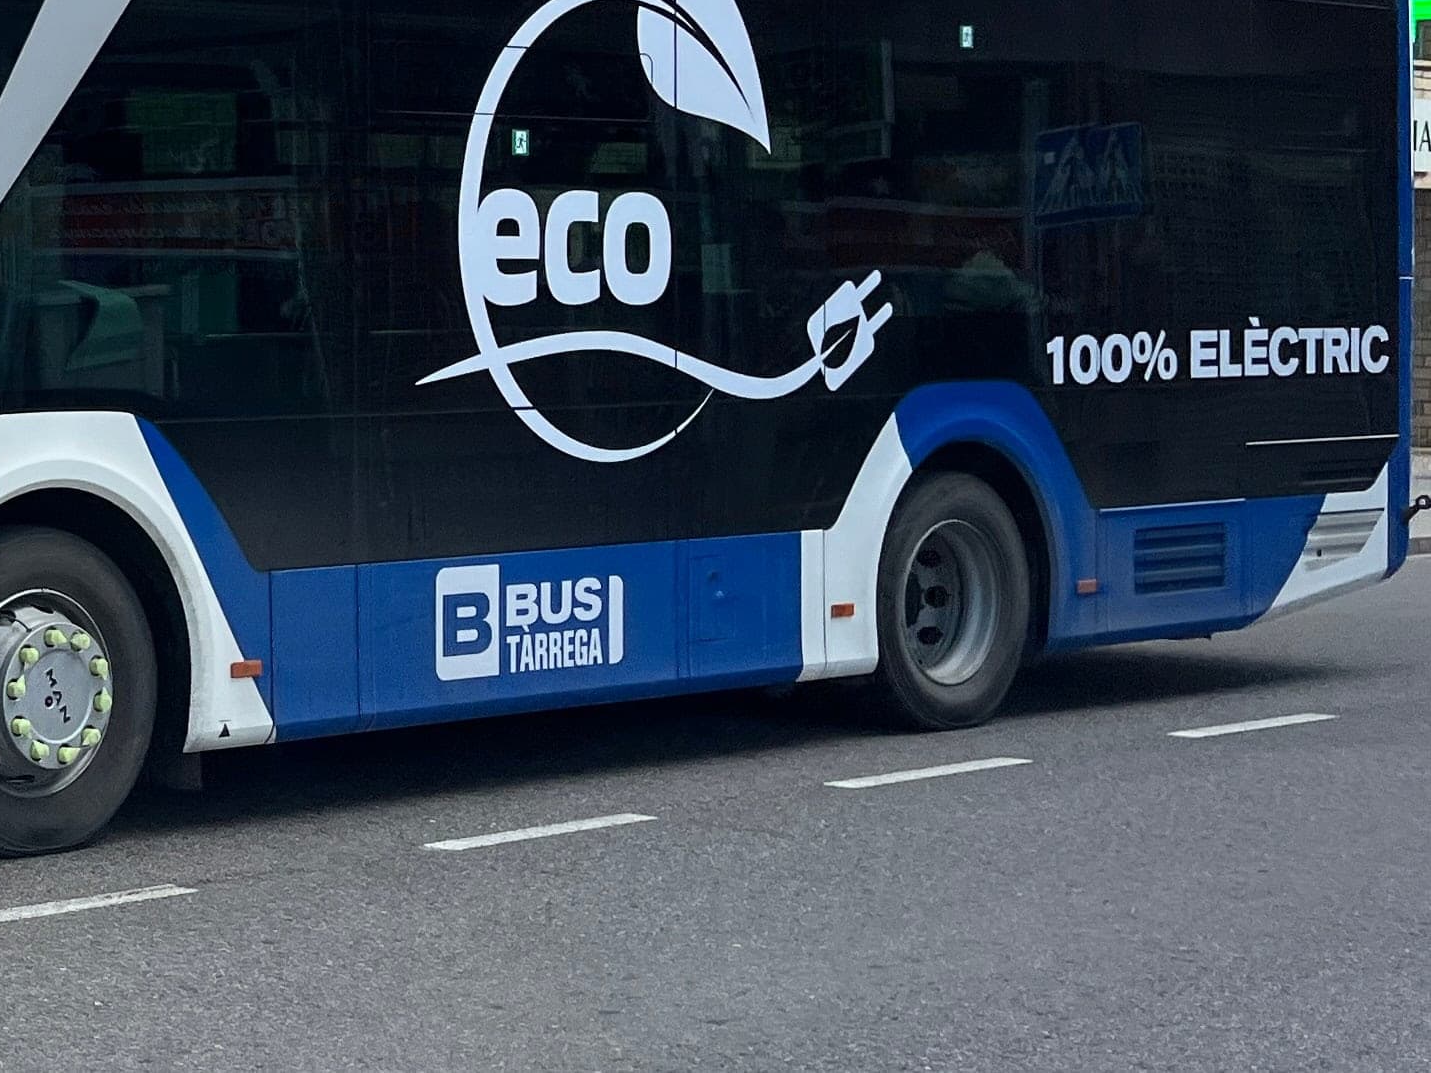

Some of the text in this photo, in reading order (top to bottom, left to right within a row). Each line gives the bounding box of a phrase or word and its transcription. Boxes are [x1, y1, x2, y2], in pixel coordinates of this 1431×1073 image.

[475, 188, 671, 306] eco
[1046, 316, 1390, 385] 100% ELÈCTRIC
[505, 577, 603, 627] BUS
[506, 625, 603, 674] TÀRREGA
